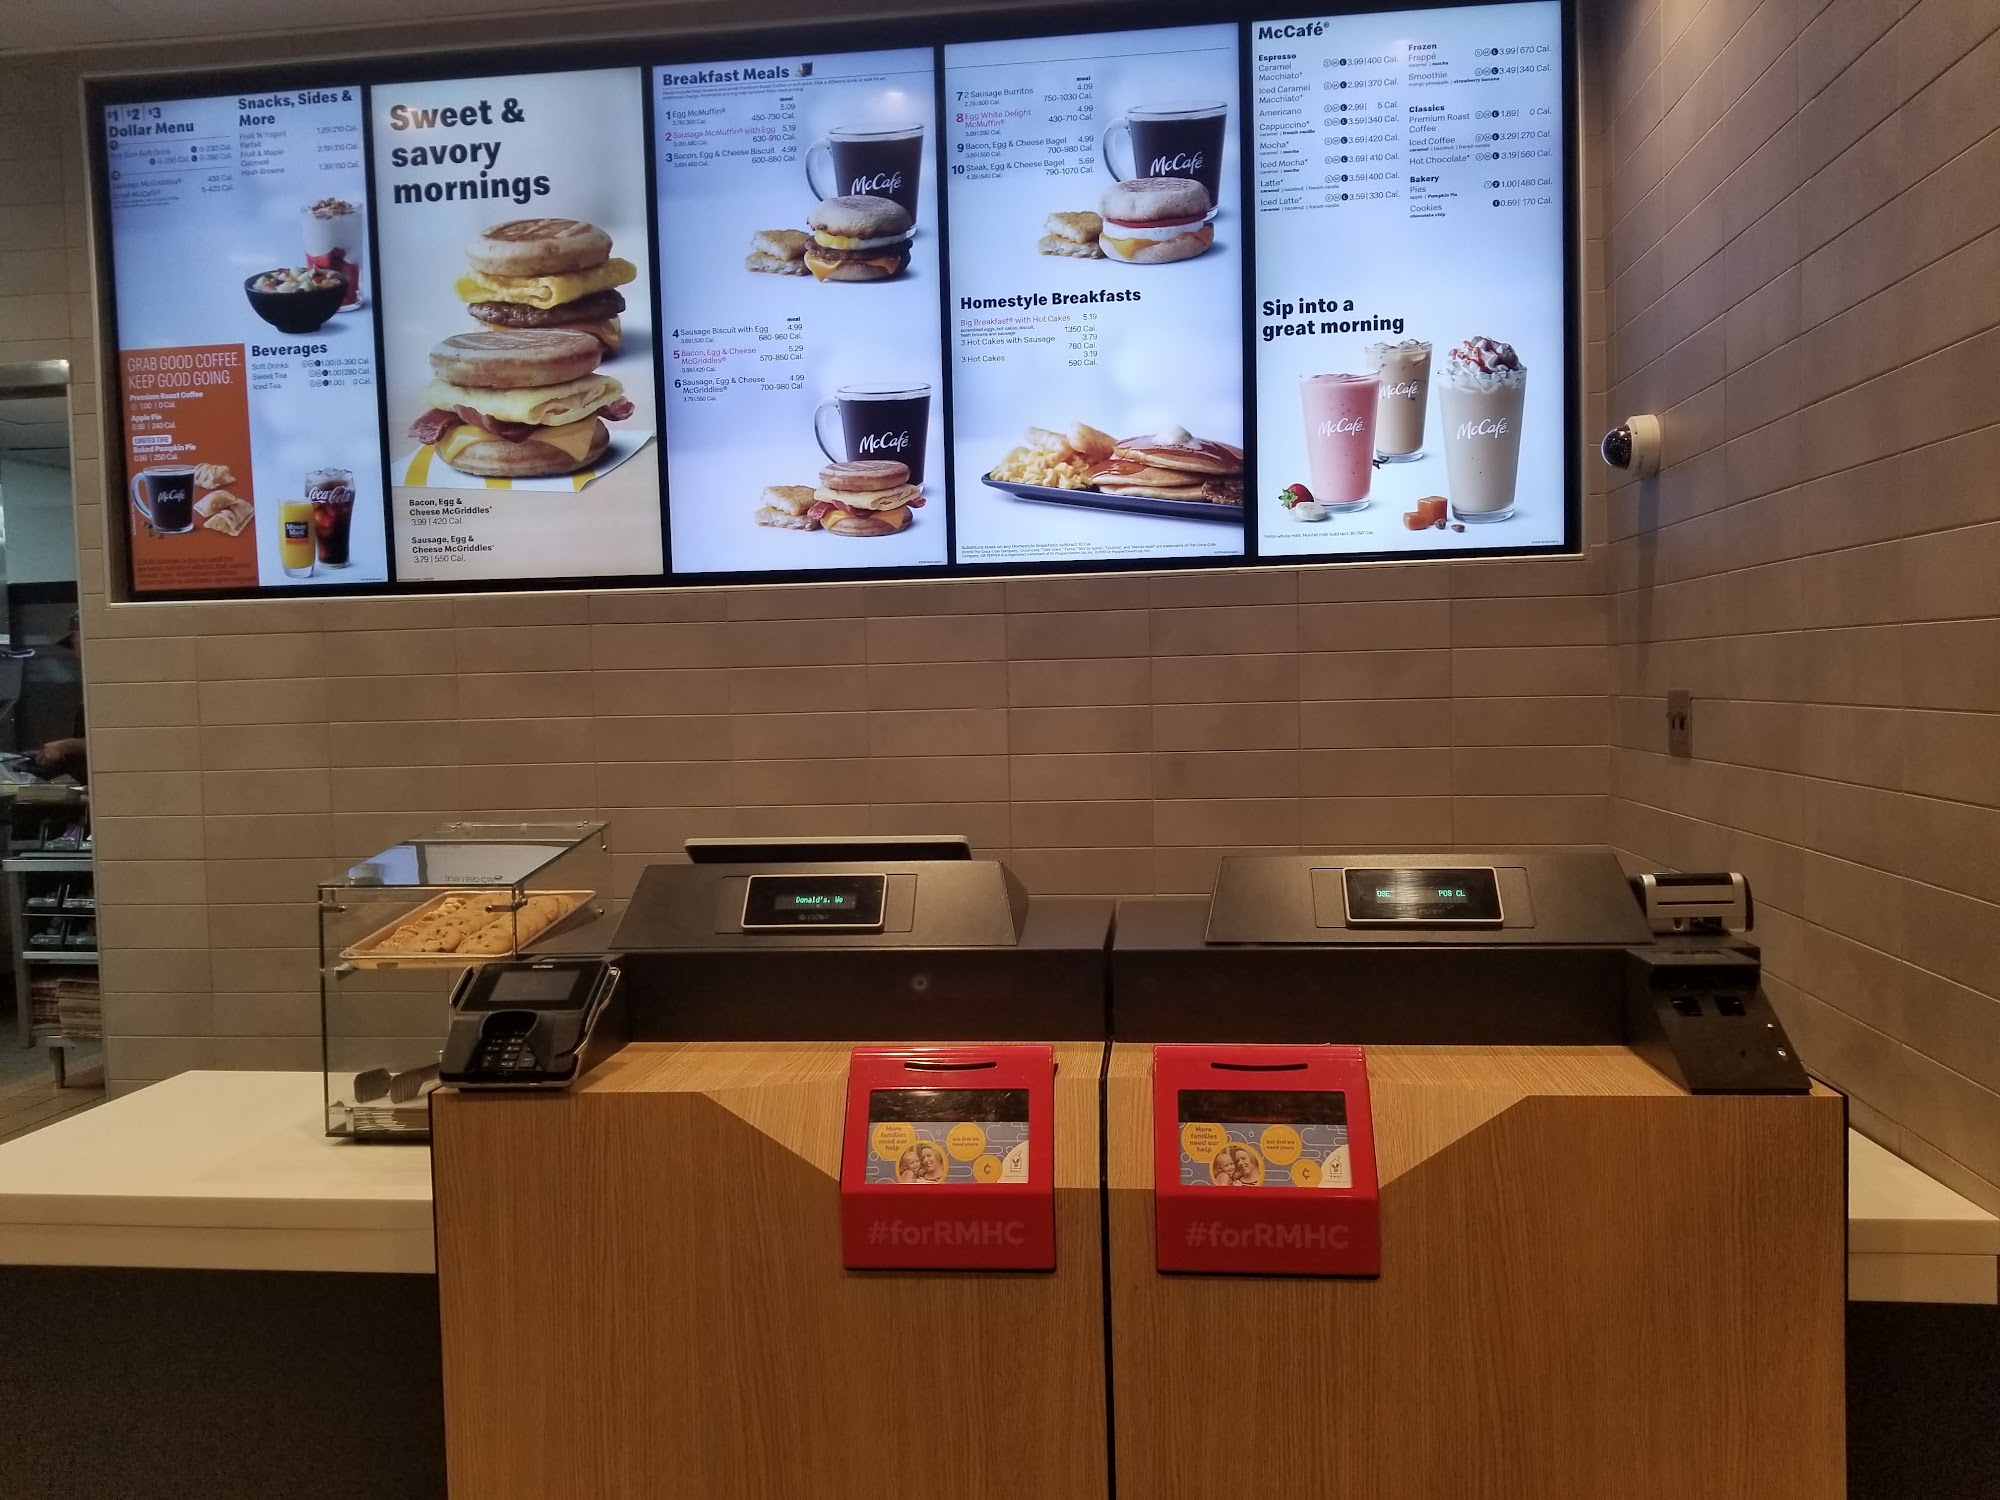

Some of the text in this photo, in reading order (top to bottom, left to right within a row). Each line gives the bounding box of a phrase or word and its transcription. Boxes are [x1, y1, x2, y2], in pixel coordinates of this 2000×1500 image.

[1259, 54, 1297, 62] Espresso
[1409, 52, 1437, 62] Frappé
[1259, 63, 1291, 72] Caramel
[663, 66, 790, 86] Breakfast Meals
[1408, 72, 1448, 81] Smoothie
[1259, 84, 1311, 94] Iced Caramel
[239, 90, 352, 110] Snacks, Sides &
[956, 91, 964, 101] 7
[970, 90, 1002, 98] Sausage
[780, 103, 796, 111] 5.09
[1259, 108, 1302, 117] Americano
[1409, 105, 1445, 113] Classics
[390, 97, 525, 131] Sweet &
[665, 111, 671, 120] 1
[673, 110, 686, 118] Egg
[956, 109, 1031, 123] 8 Egg White Delight
[1409, 113, 1470, 124] Premium Roast
[239, 114, 275, 127] More
[109, 122, 194, 137] Dollar Menu
[665, 132, 672, 141] 2
[673, 130, 704, 139] Sausage
[762, 126, 776, 134] Egg
[1409, 125, 1437, 133] Coffee
[1410, 137, 1456, 146] Iced Coffee
[391, 141, 501, 170] savory
[665, 153, 672, 163] 3
[700, 151, 713, 159] Egg
[751, 147, 775, 155] Biscuit
[952, 165, 964, 174] 10
[966, 164, 989, 172] Steak,
[991, 163, 1005, 171] Egg
[1013, 160, 1042, 168] Cheese
[1043, 158, 1065, 167] Bagel
[1260, 160, 1277, 168] Iced
[1410, 157, 1424, 165] Hot
[1410, 175, 1439, 183] Bakery
[394, 170, 550, 204] mornings
[1260, 197, 1278, 206] Iced
[1410, 204, 1442, 212] Cookies
[960, 290, 1141, 310] Homestyle Breakfasts
[1262, 298, 1354, 319] Sip into a
[960, 319, 973, 328] Big
[1015, 316, 1031, 324] with
[1032, 315, 1046, 323] Hot
[1048, 314, 1071, 322] Cakes
[1082, 313, 1098, 321] 5.19
[672, 329, 680, 338] 4
[680, 328, 711, 336] Sausage
[712, 327, 737, 335] Biscuit
[755, 326, 769, 334] Egg
[1262, 314, 1404, 342] great morning
[967, 338, 980, 346] Hot
[982, 337, 1005, 345] Cakes
[1006, 336, 1022, 344] with
[1023, 336, 1056, 344] Sausage
[252, 344, 327, 357] Beverages
[673, 350, 680, 359] 5
[681, 349, 705, 357] Bacon,
[707, 348, 721, 356] Egg
[128, 352, 241, 372] GRAB GOOD COFFEE.
[128, 370, 233, 389] KEEP GOOD GOING.
[409, 499, 437, 507] Bacon,
[439, 498, 454, 506] Egg
[409, 508, 440, 516] Cheese
[412, 536, 449, 545] Sausage,
[451, 535, 466, 544] Egg
[412, 546, 442, 554] Cheese
[867, 1219, 1025, 1245] #forRMHC
[1185, 1222, 1350, 1249] #forRMHC
